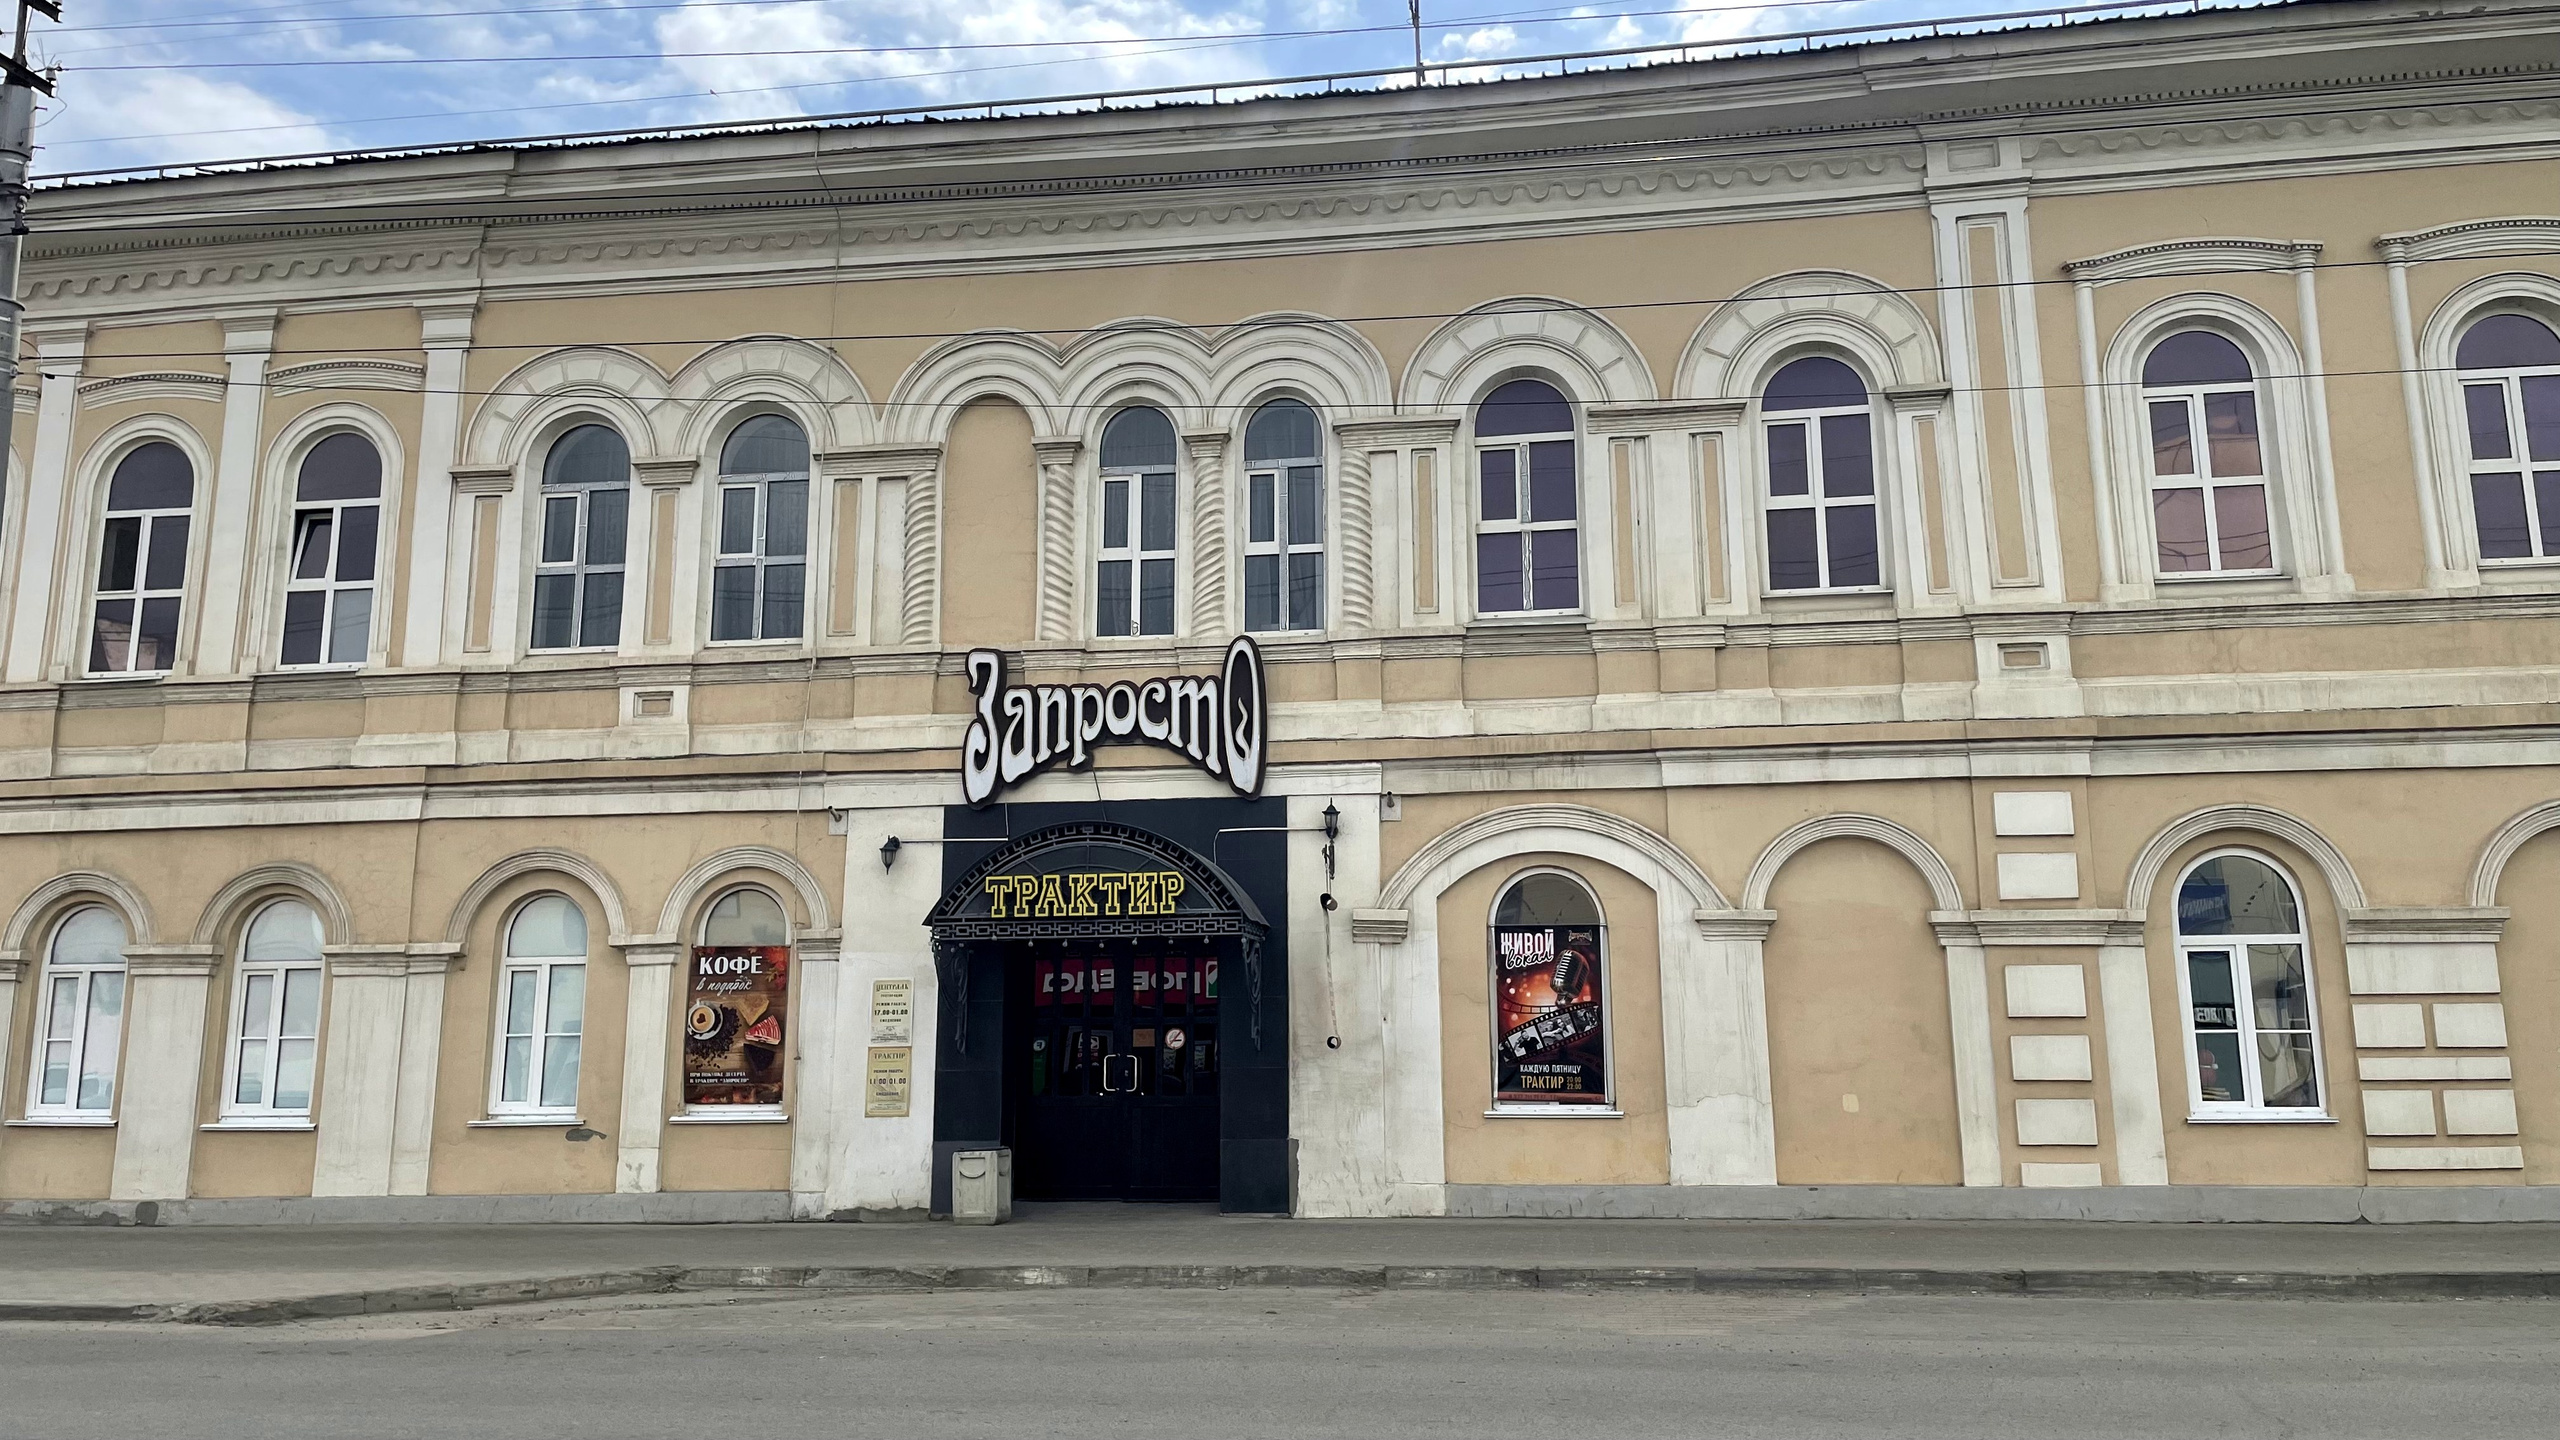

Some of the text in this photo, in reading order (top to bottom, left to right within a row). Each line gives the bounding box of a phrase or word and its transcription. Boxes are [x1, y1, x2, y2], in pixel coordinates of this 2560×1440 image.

[964, 638, 1264, 804] Запросто
[985, 871, 1186, 917] ТРАКТИР
[1500, 929, 1555, 955] ЖИВОЙ
[699, 956, 763, 975] КОФЕ
[1506, 948, 1553, 969] вокал
[696, 977, 753, 996] в подарок
[1519, 1064, 1581, 1074] КАЖДУЮ ПЯТНИЦУ
[1521, 1075, 1564, 1089] ТРАКТИР
